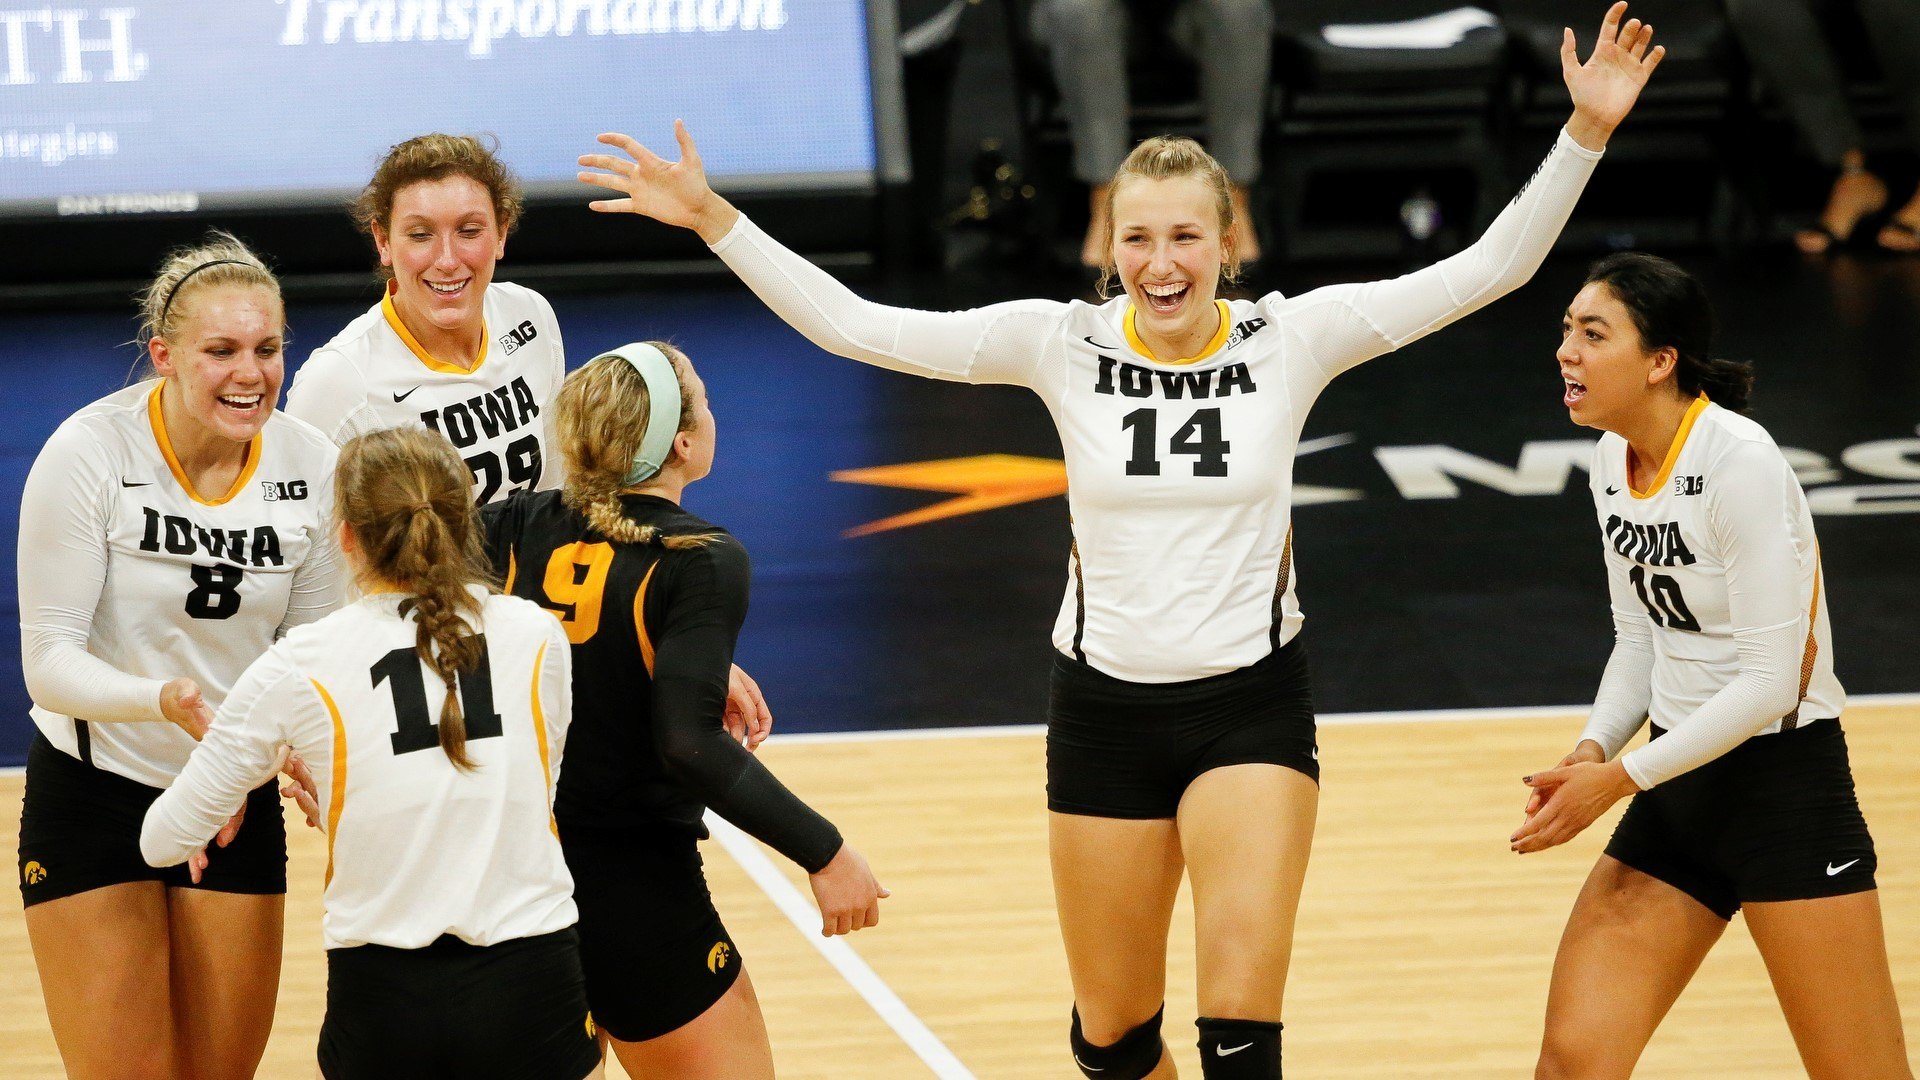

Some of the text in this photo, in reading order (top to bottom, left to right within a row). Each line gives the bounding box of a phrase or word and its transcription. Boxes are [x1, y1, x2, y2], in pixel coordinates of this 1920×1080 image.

[1094, 354, 1257, 400] IOWA
[420, 376, 539, 449] IOWA
[1121, 407, 1230, 477] 14
[463, 434, 543, 507] 29
[139, 506, 284, 567] IOWA
[1605, 514, 1697, 567] IOWA
[184, 563, 243, 620] 8
[542, 540, 615, 645] 9
[1629, 565, 1701, 632] 10
[370, 633, 504, 756] 11
